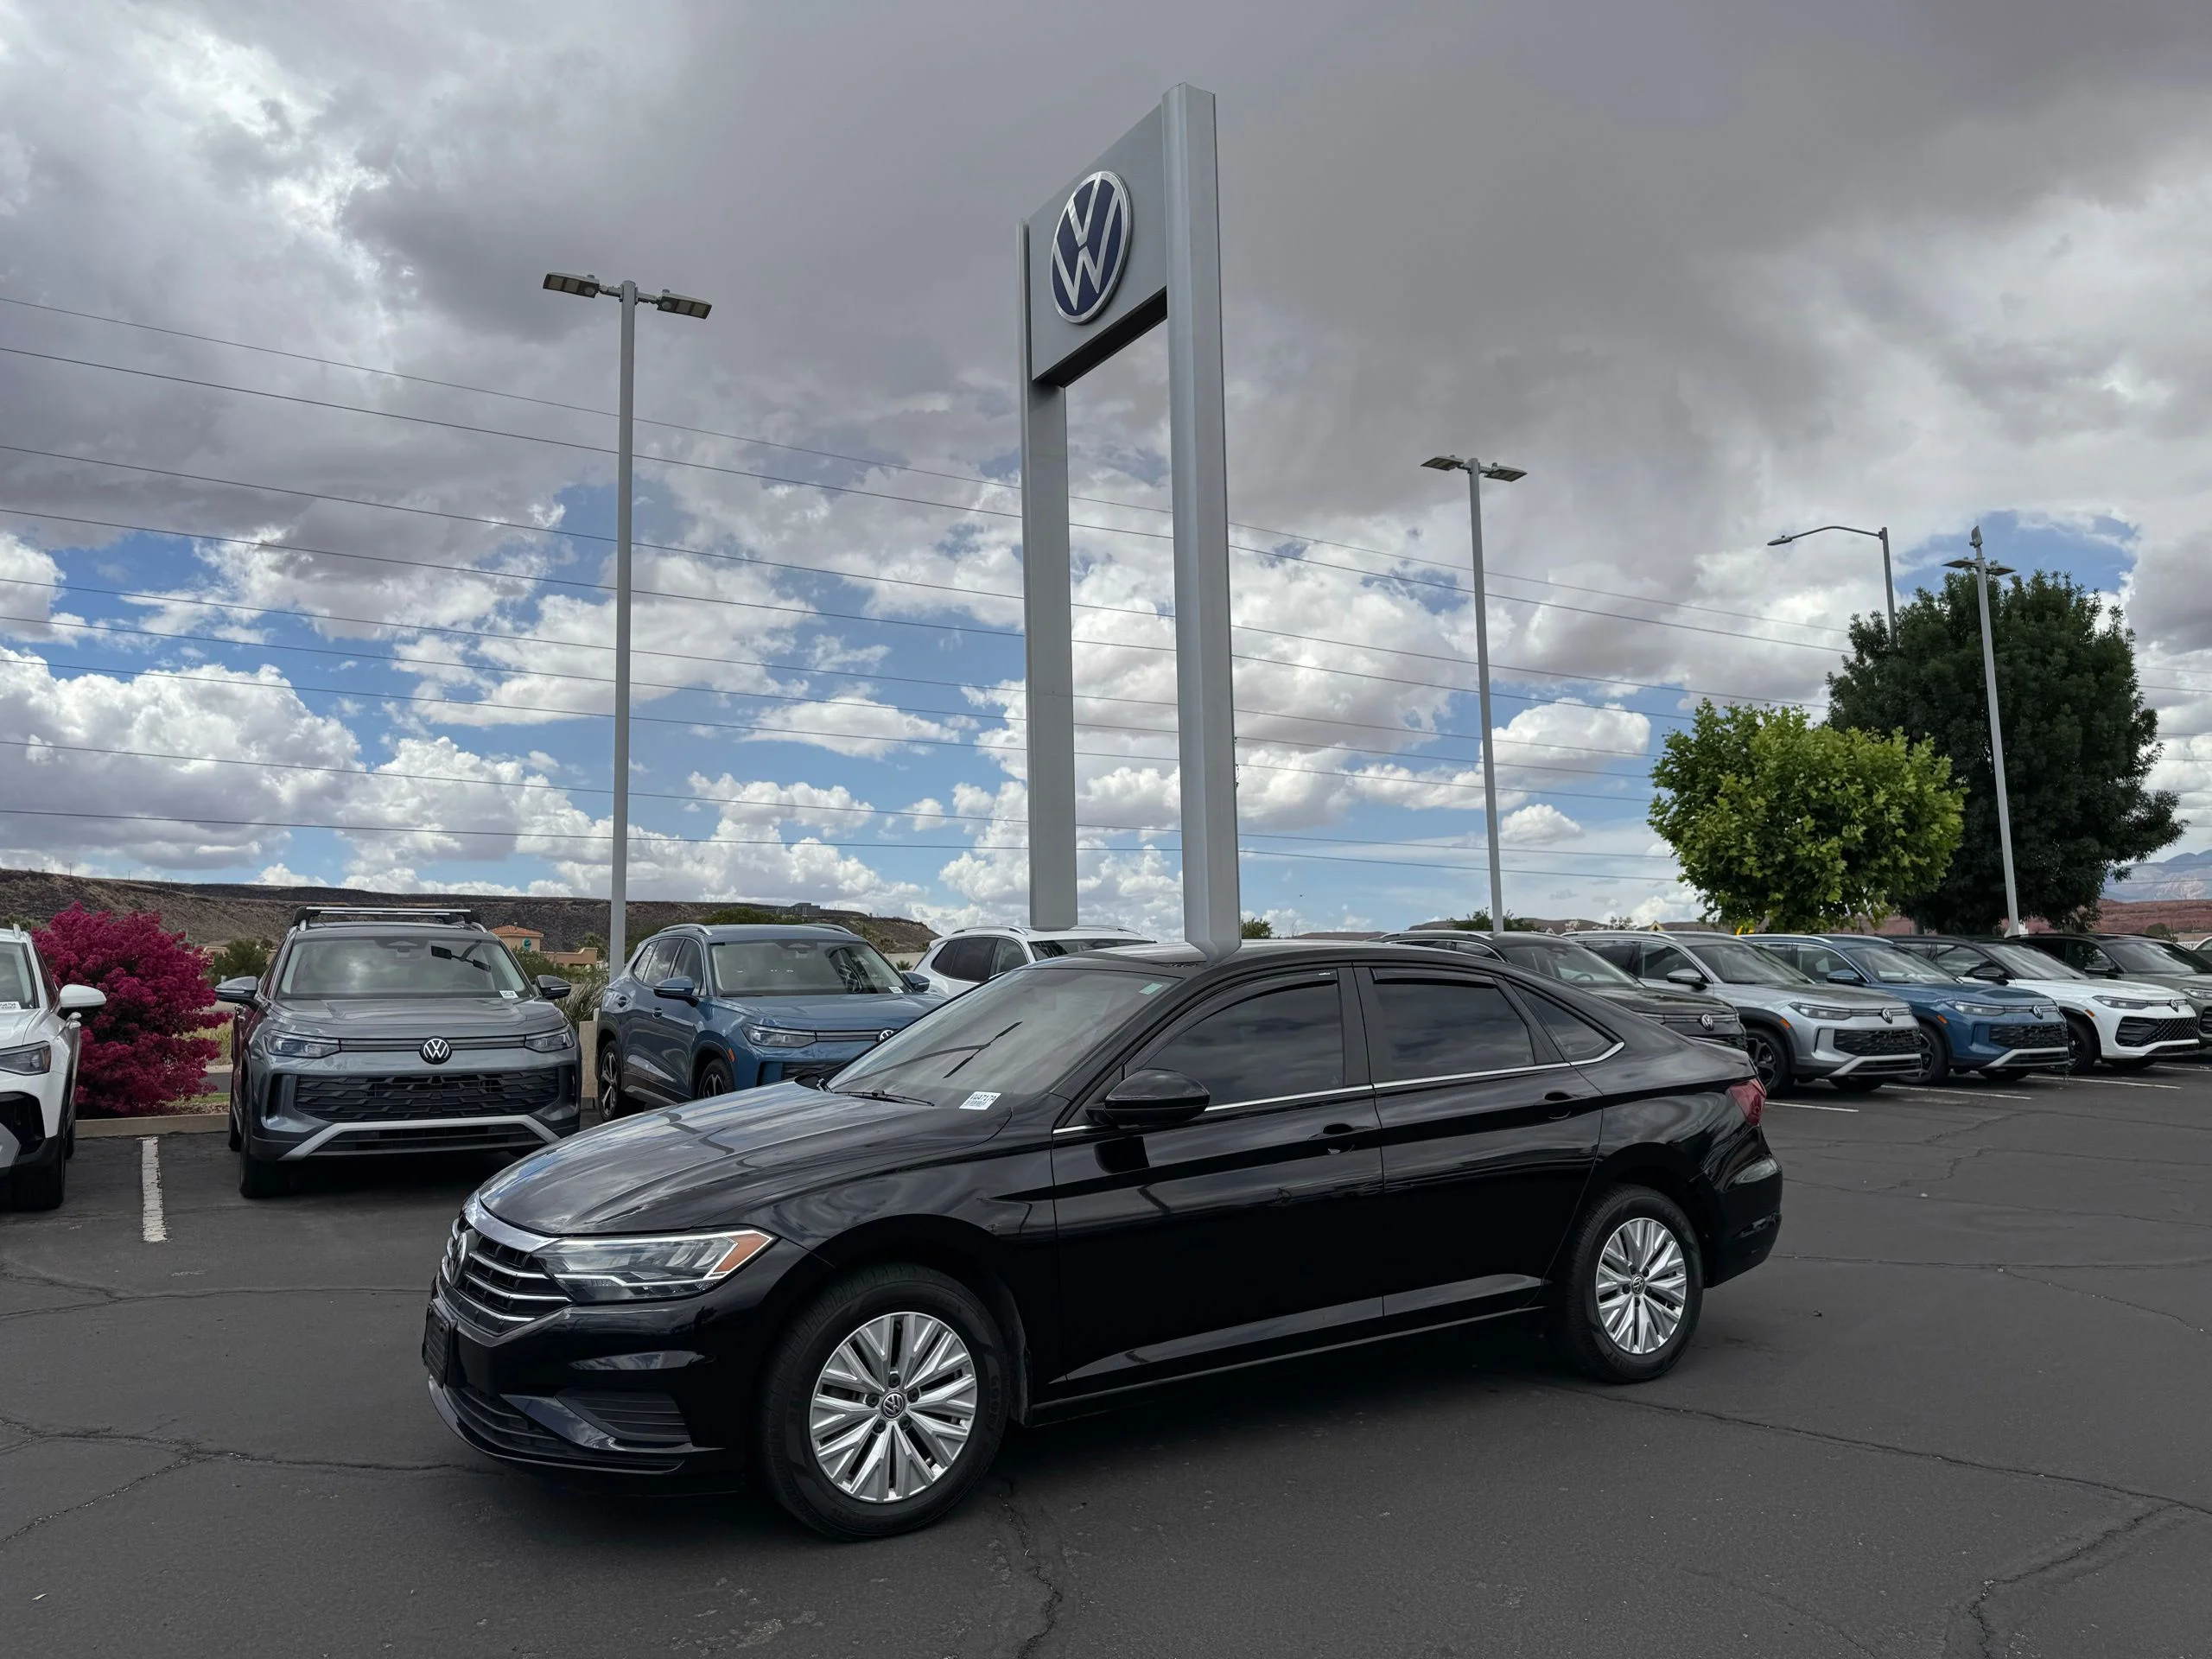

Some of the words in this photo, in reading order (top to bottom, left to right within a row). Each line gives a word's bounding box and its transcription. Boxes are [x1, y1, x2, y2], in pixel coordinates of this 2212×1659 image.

[1051, 172, 1124, 318] VW
[423, 1038, 449, 1060] VW
[883, 1393, 905, 1417] VW
